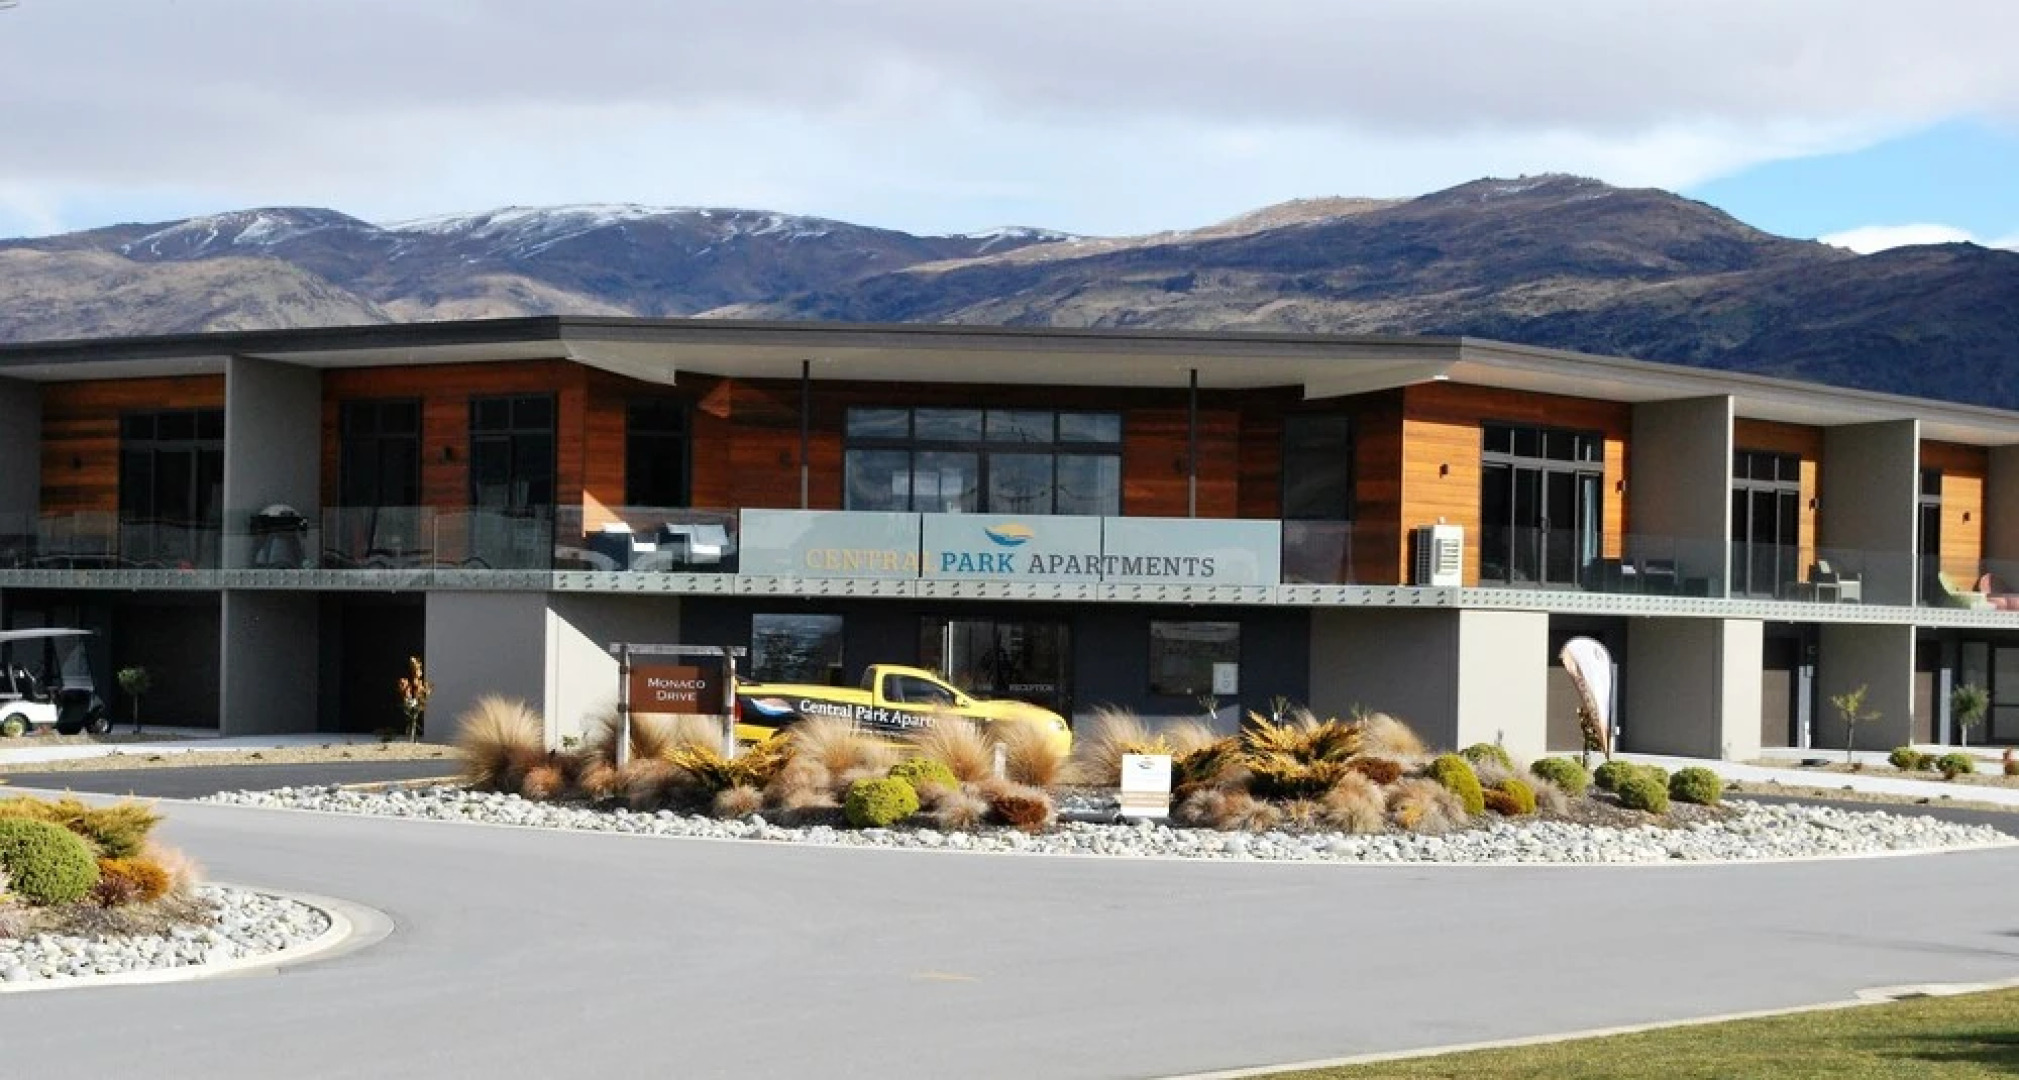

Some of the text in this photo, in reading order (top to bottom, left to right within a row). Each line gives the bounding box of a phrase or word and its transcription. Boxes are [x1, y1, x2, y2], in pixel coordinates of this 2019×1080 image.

[806, 549, 1216, 578] CENTRAL PARK APARTMENTS
[799, 699, 851, 718] Central
[855, 705, 890, 724] Park
